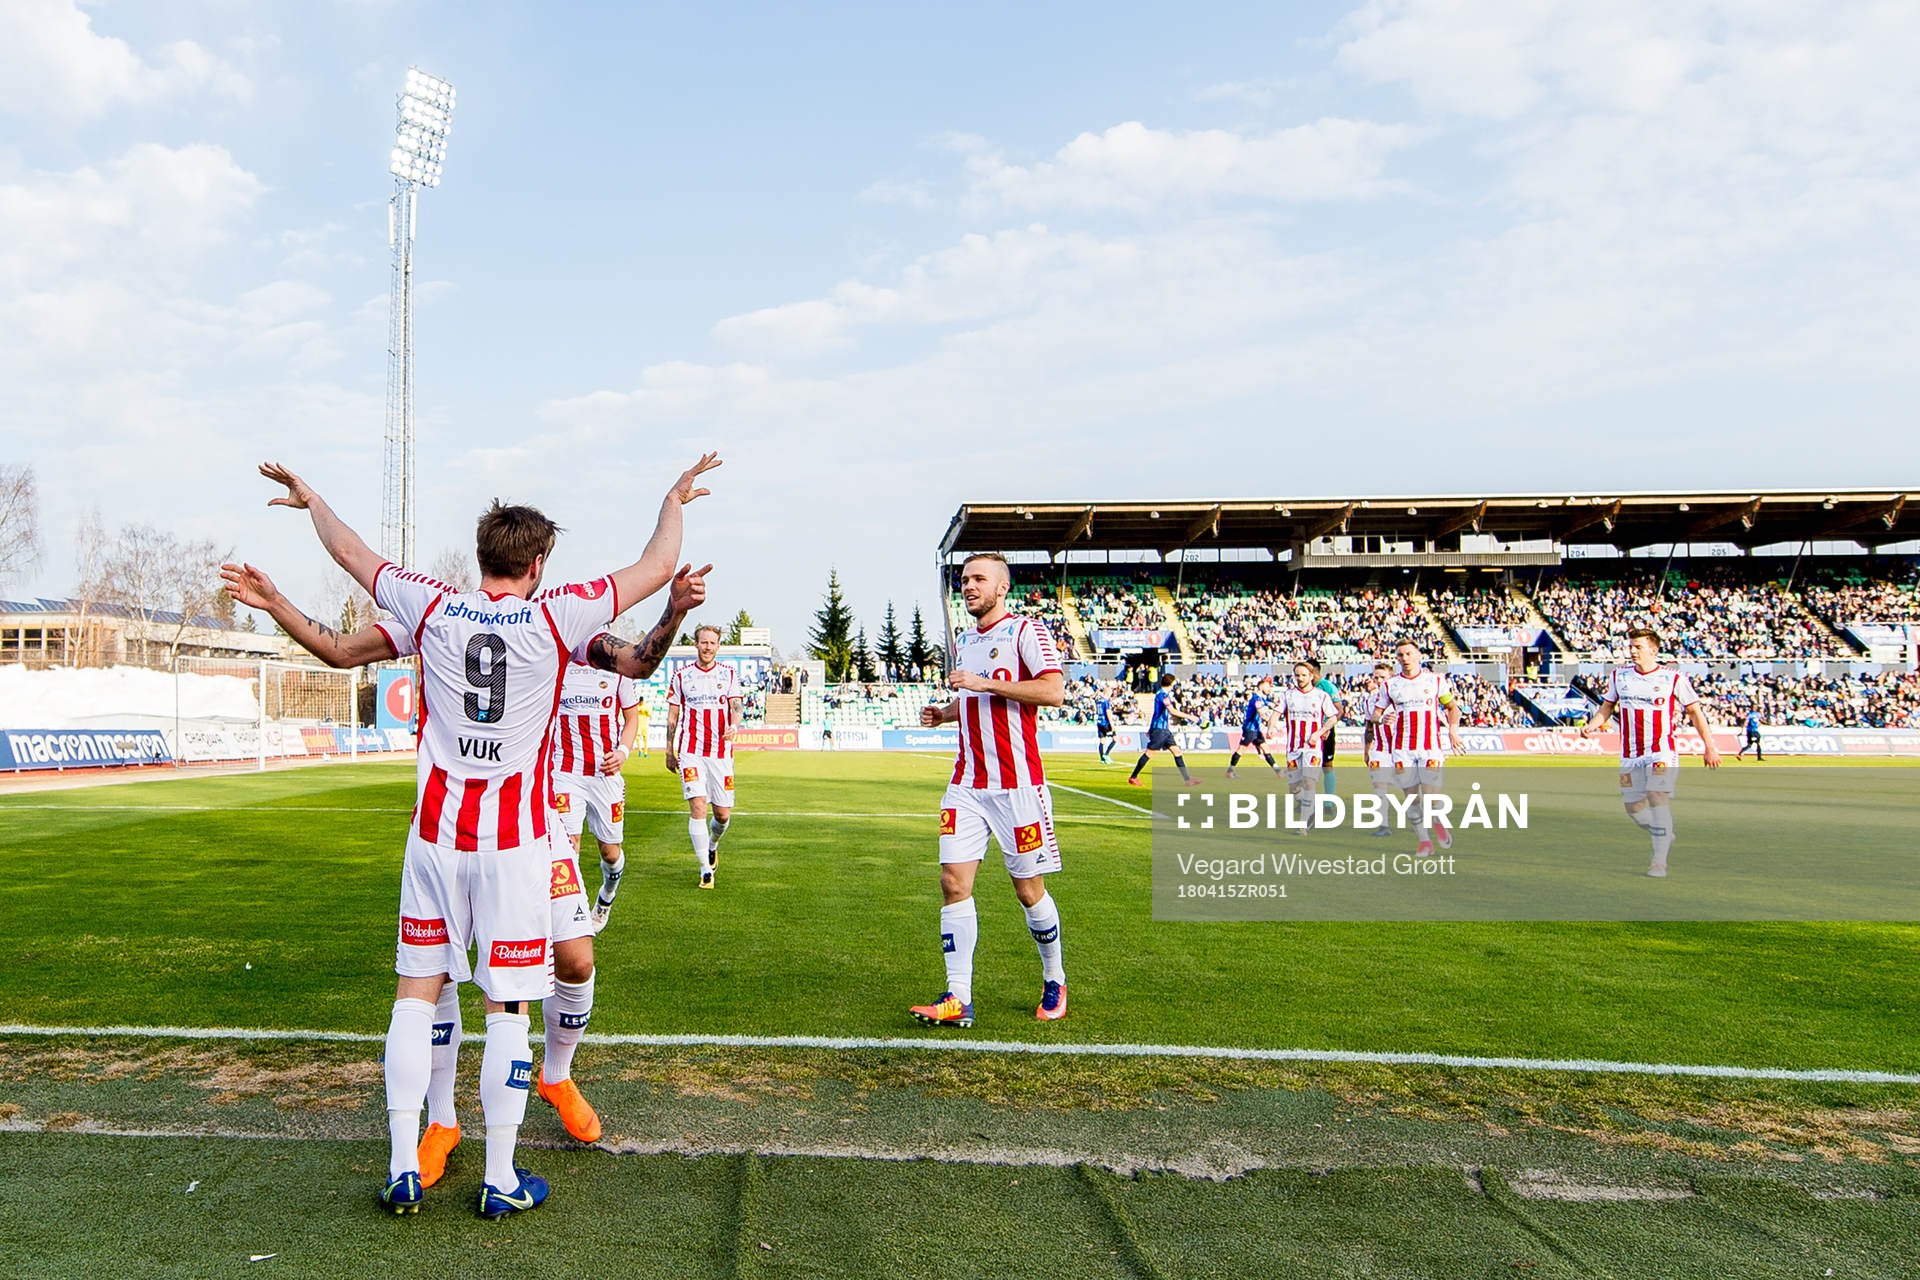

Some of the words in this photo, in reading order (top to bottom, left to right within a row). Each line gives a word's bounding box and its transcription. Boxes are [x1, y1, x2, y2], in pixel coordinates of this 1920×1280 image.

[1184, 554, 1200, 562] 202
[444, 601, 532, 626] Ishavskraft
[463, 633, 507, 723] 9
[398, 684, 411, 714] 1
[560, 695, 600, 705] areBank
[8, 734, 97, 764] macron
[93, 733, 172, 760] macron
[457, 737, 504, 761] VUK
[1523, 734, 1603, 752] altibox
[1018, 839, 1042, 852] EXTRA
